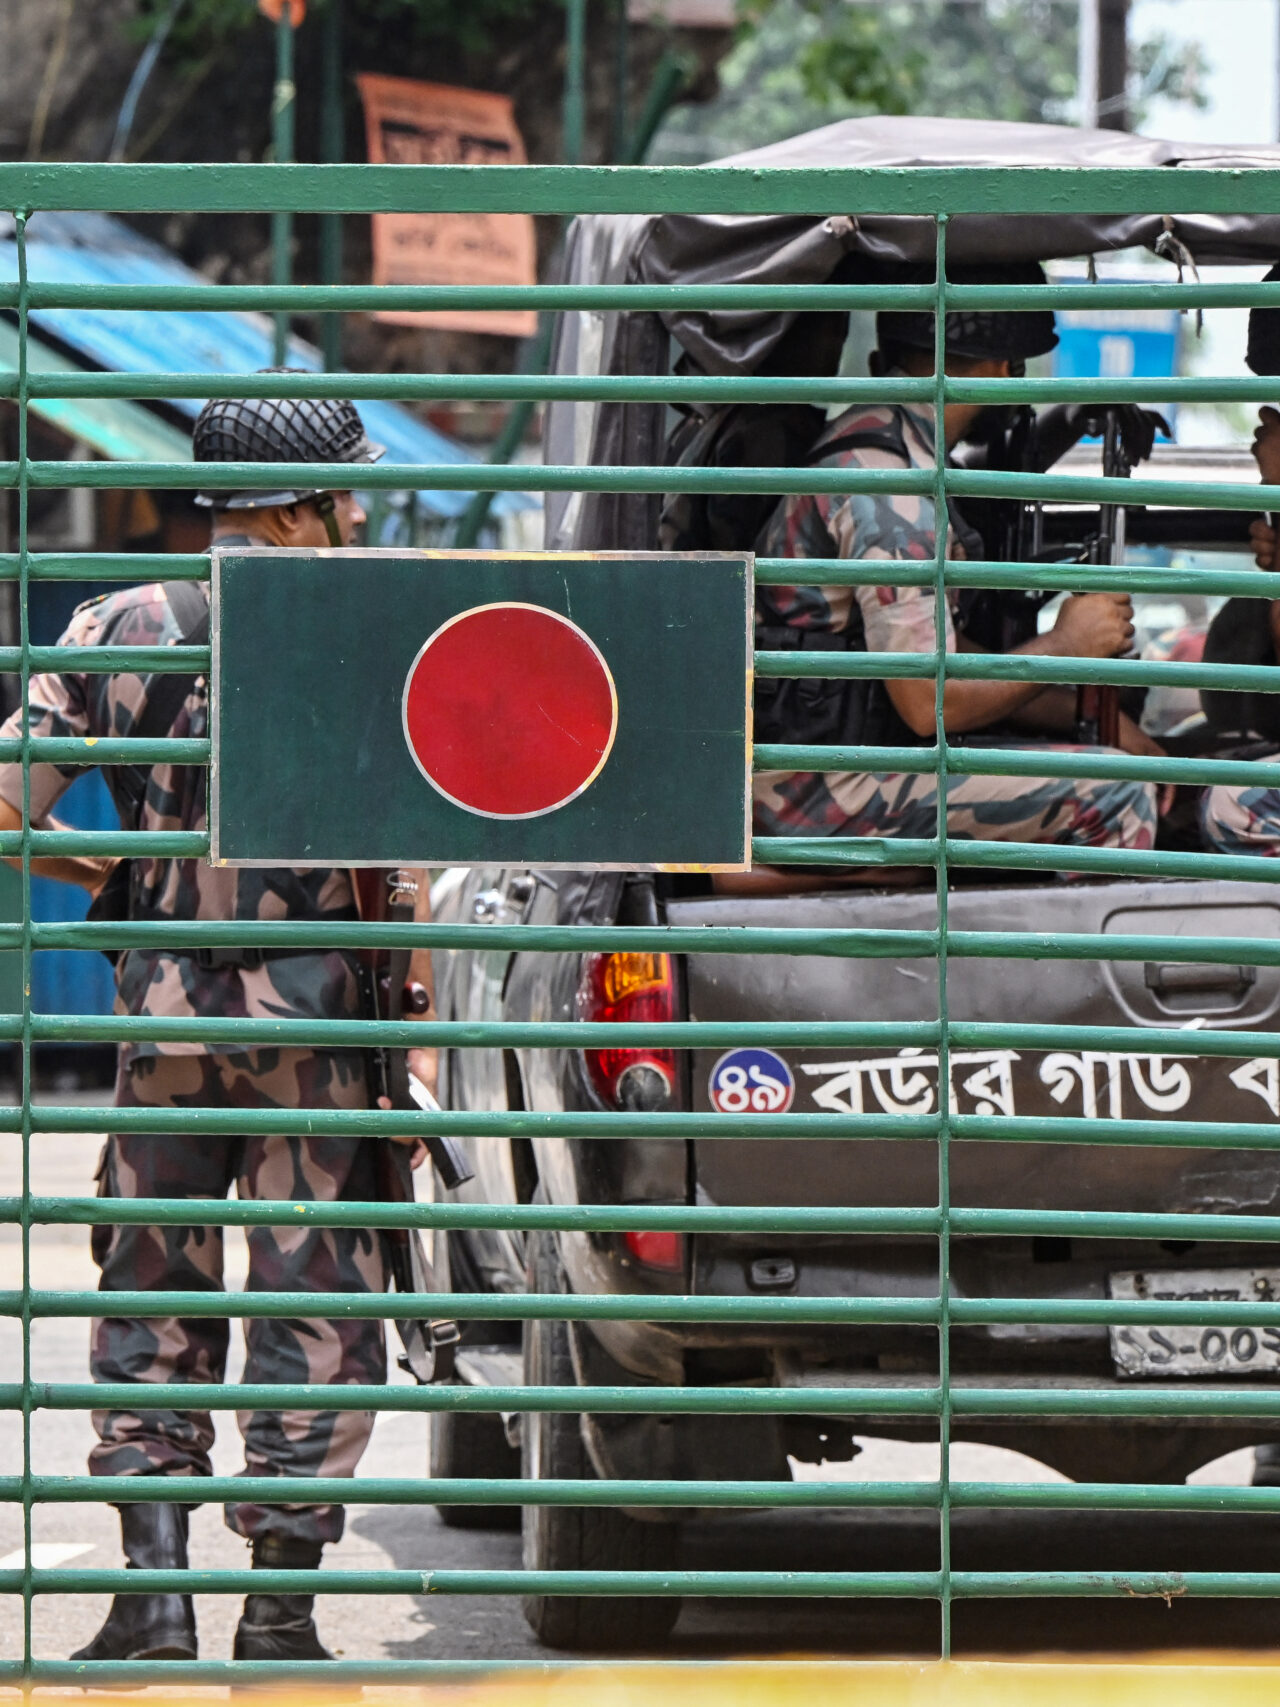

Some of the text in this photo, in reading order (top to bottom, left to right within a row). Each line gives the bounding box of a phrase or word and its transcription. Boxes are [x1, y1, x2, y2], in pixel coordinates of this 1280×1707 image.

[718, 1064, 786, 1112] ৪৯
[800, 1047, 1021, 1117] বর্ডার
[1039, 1017, 1206, 1119] গার্ড
